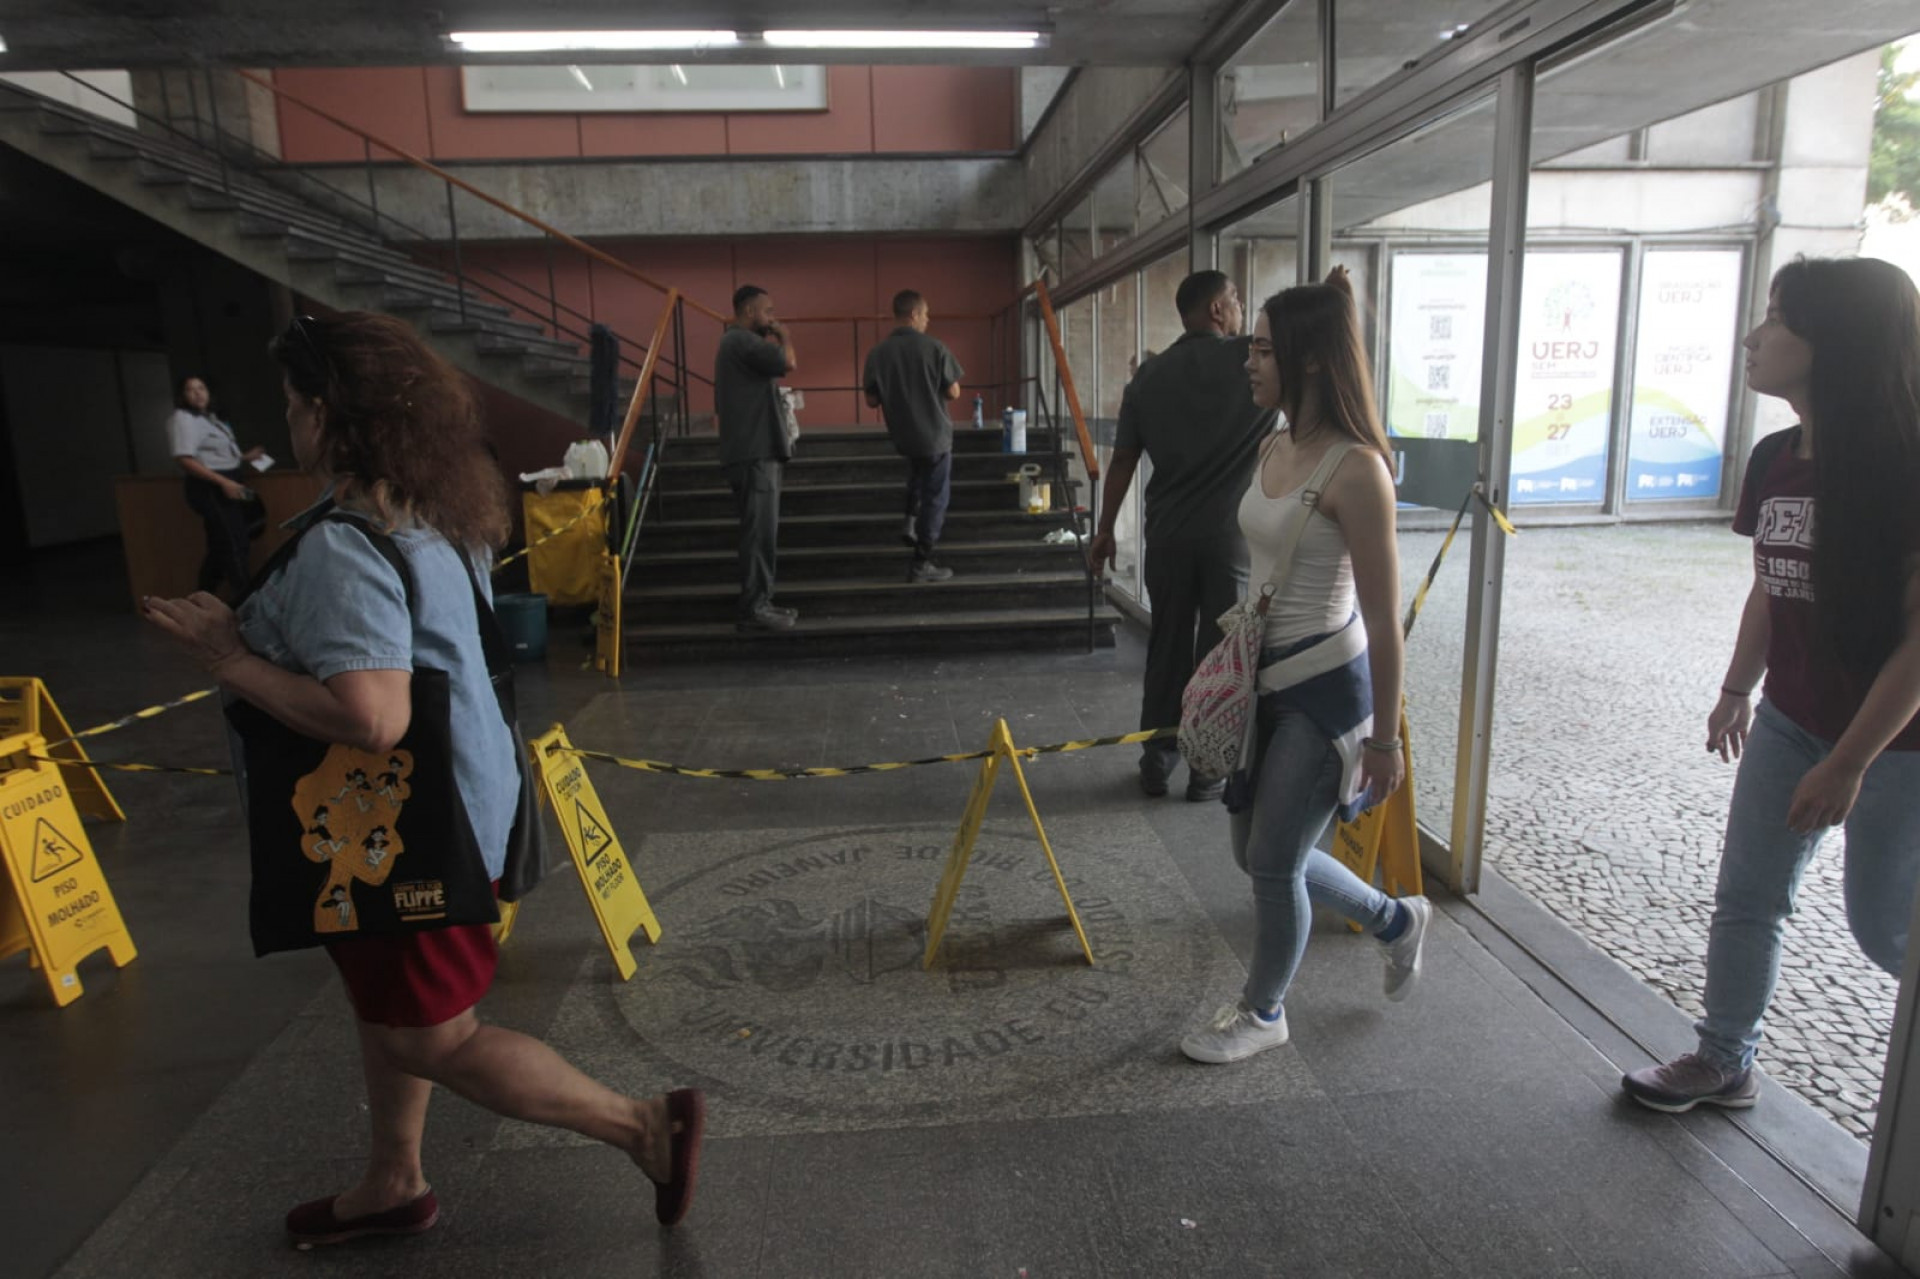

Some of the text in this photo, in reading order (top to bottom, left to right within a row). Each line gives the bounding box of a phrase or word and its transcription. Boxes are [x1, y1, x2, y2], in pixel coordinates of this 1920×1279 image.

[1658, 289, 1704, 304] UERJ
[1531, 340, 1599, 360] UERJ
[1653, 363, 1693, 376] UERJ
[1548, 393, 1573, 411] 23
[1547, 424, 1571, 441] 27
[1648, 426, 1688, 440] UERJ
[1768, 557, 1810, 580] 1950
[2, 784, 63, 821] CUIDADO
[595, 853, 612, 873] PISO
[895, 845, 942, 861] DE
[594, 858, 623, 893] MOLHADO
[719, 846, 872, 897] JANEIRO
[53, 877, 78, 898] PISO
[47, 889, 101, 928] MOLHADO
